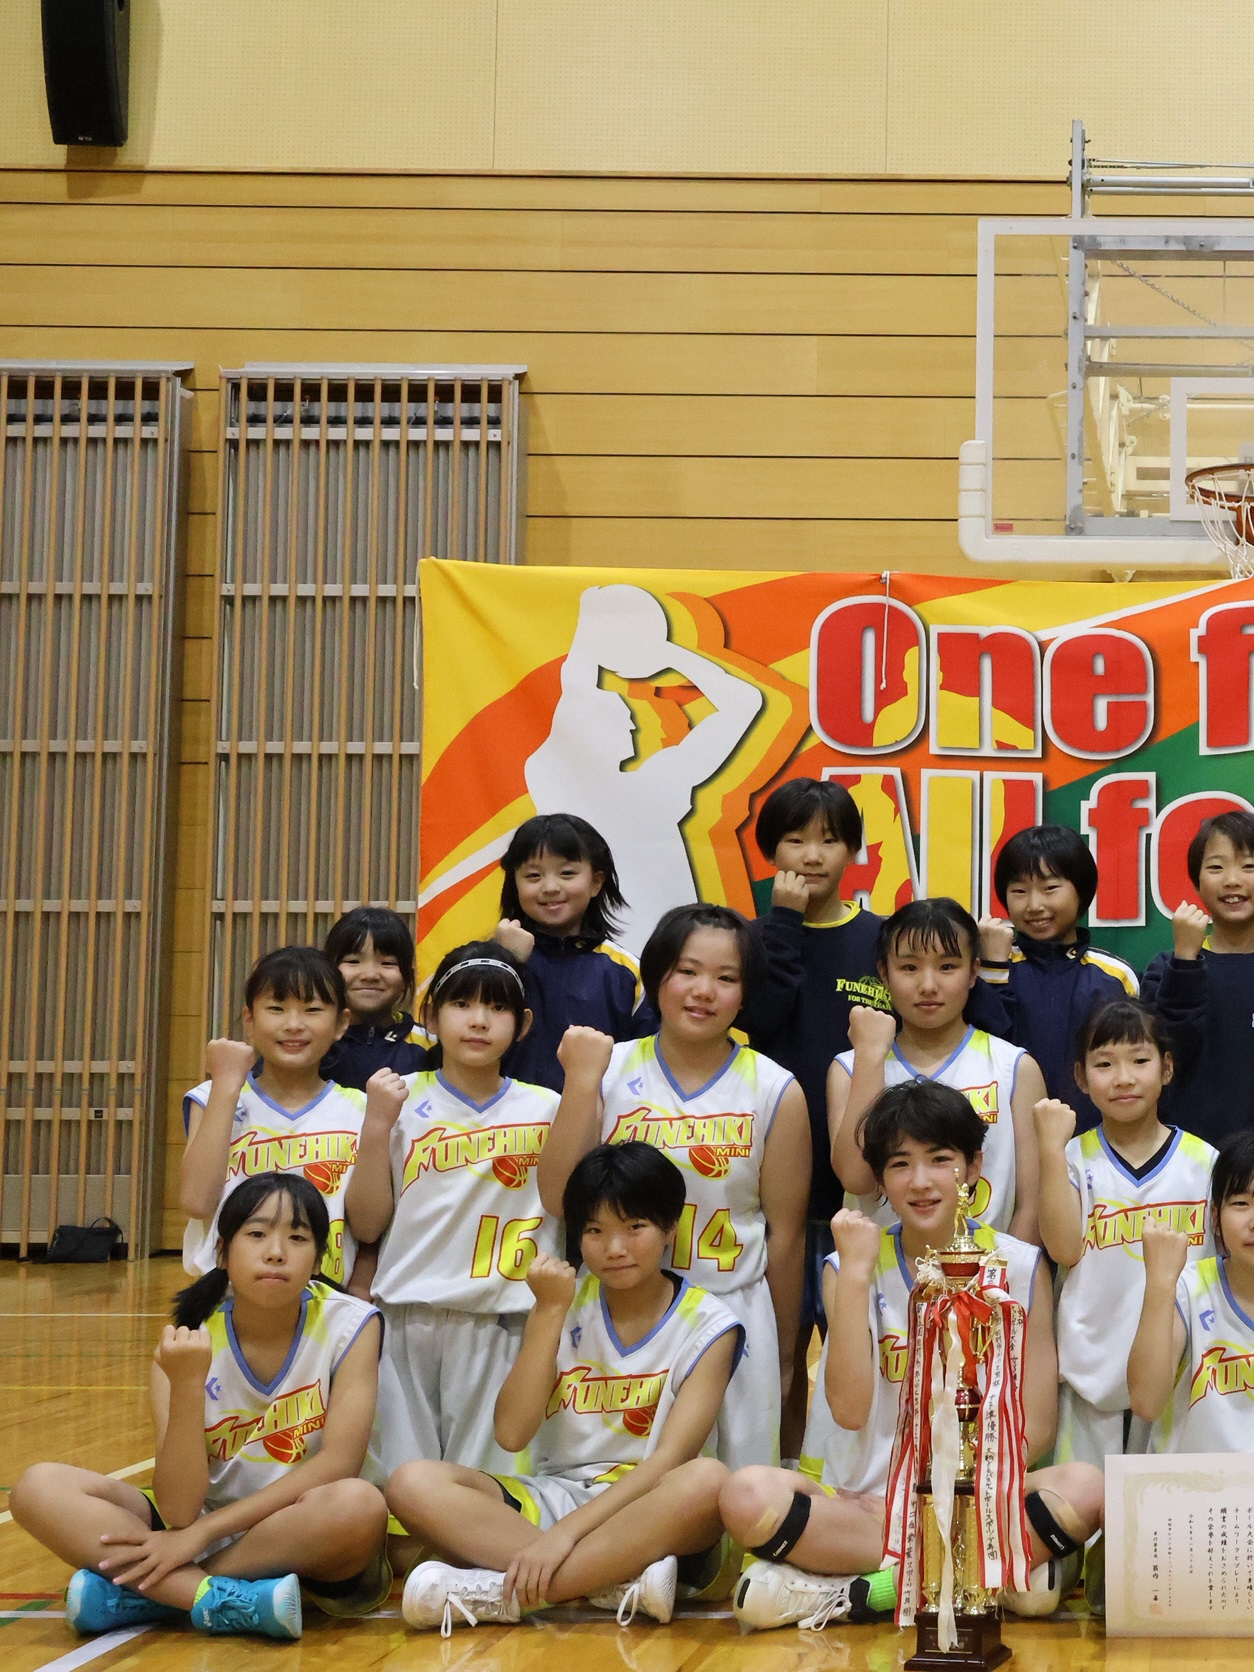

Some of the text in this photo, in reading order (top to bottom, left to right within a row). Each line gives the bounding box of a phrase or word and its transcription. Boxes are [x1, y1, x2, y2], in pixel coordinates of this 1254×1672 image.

[809, 594, 1155, 760] One
[605, 1107, 755, 1150] FUNEHIKI
[715, 1147, 751, 1157] MINI
[226, 1131, 358, 1183] FUNEHIK
[517, 1156, 540, 1167] MIN
[470, 1214, 543, 1281] 16
[671, 1204, 744, 1272] 14
[546, 1366, 669, 1420] FUNEHI
[205, 1378, 325, 1463] FUHIKI
